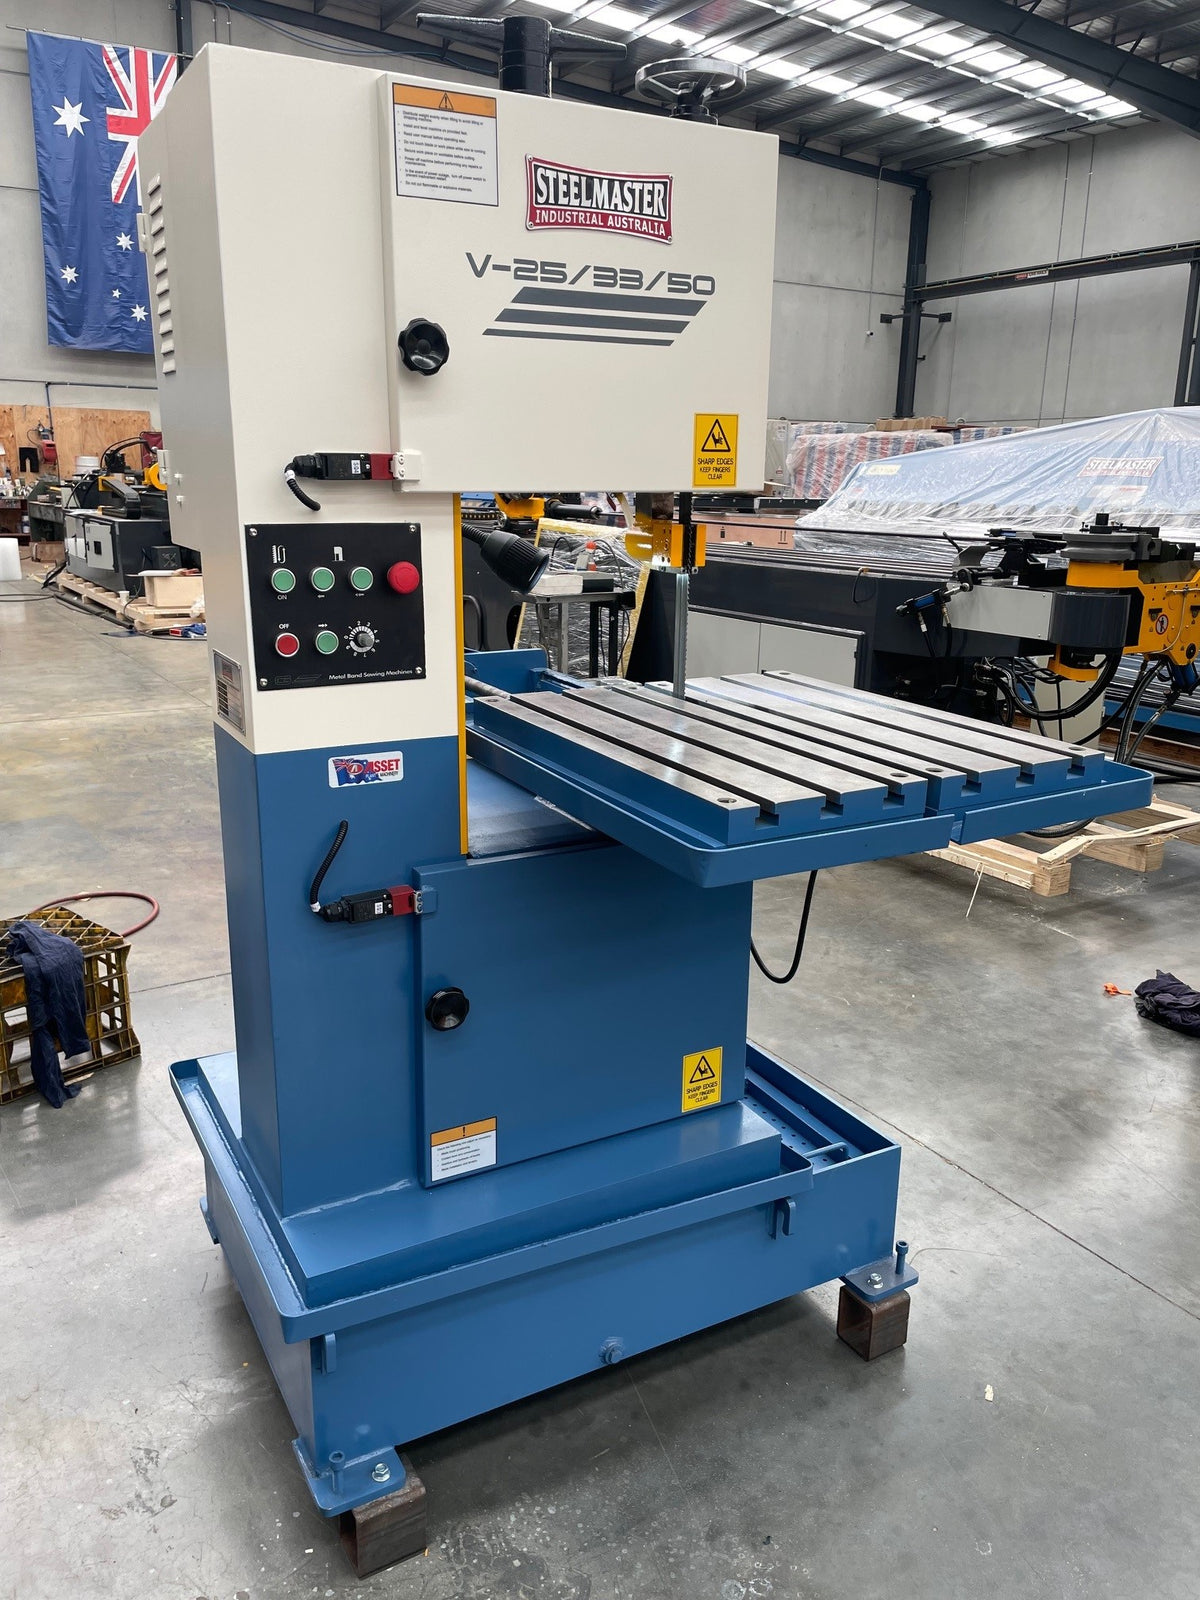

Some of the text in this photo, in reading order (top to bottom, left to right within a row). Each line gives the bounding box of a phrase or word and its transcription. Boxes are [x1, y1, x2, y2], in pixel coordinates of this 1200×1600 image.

[536, 167, 666, 217] STEELMASTER
[535, 209, 666, 237] INDUSTRIAL AUSTRALIA
[465, 252, 716, 296] V-25/33/50
[1086, 460, 1157, 470] STEELMASTER
[364, 759, 400, 773] ASSET
[686, 1081, 718, 1094] SHARP EDGES
